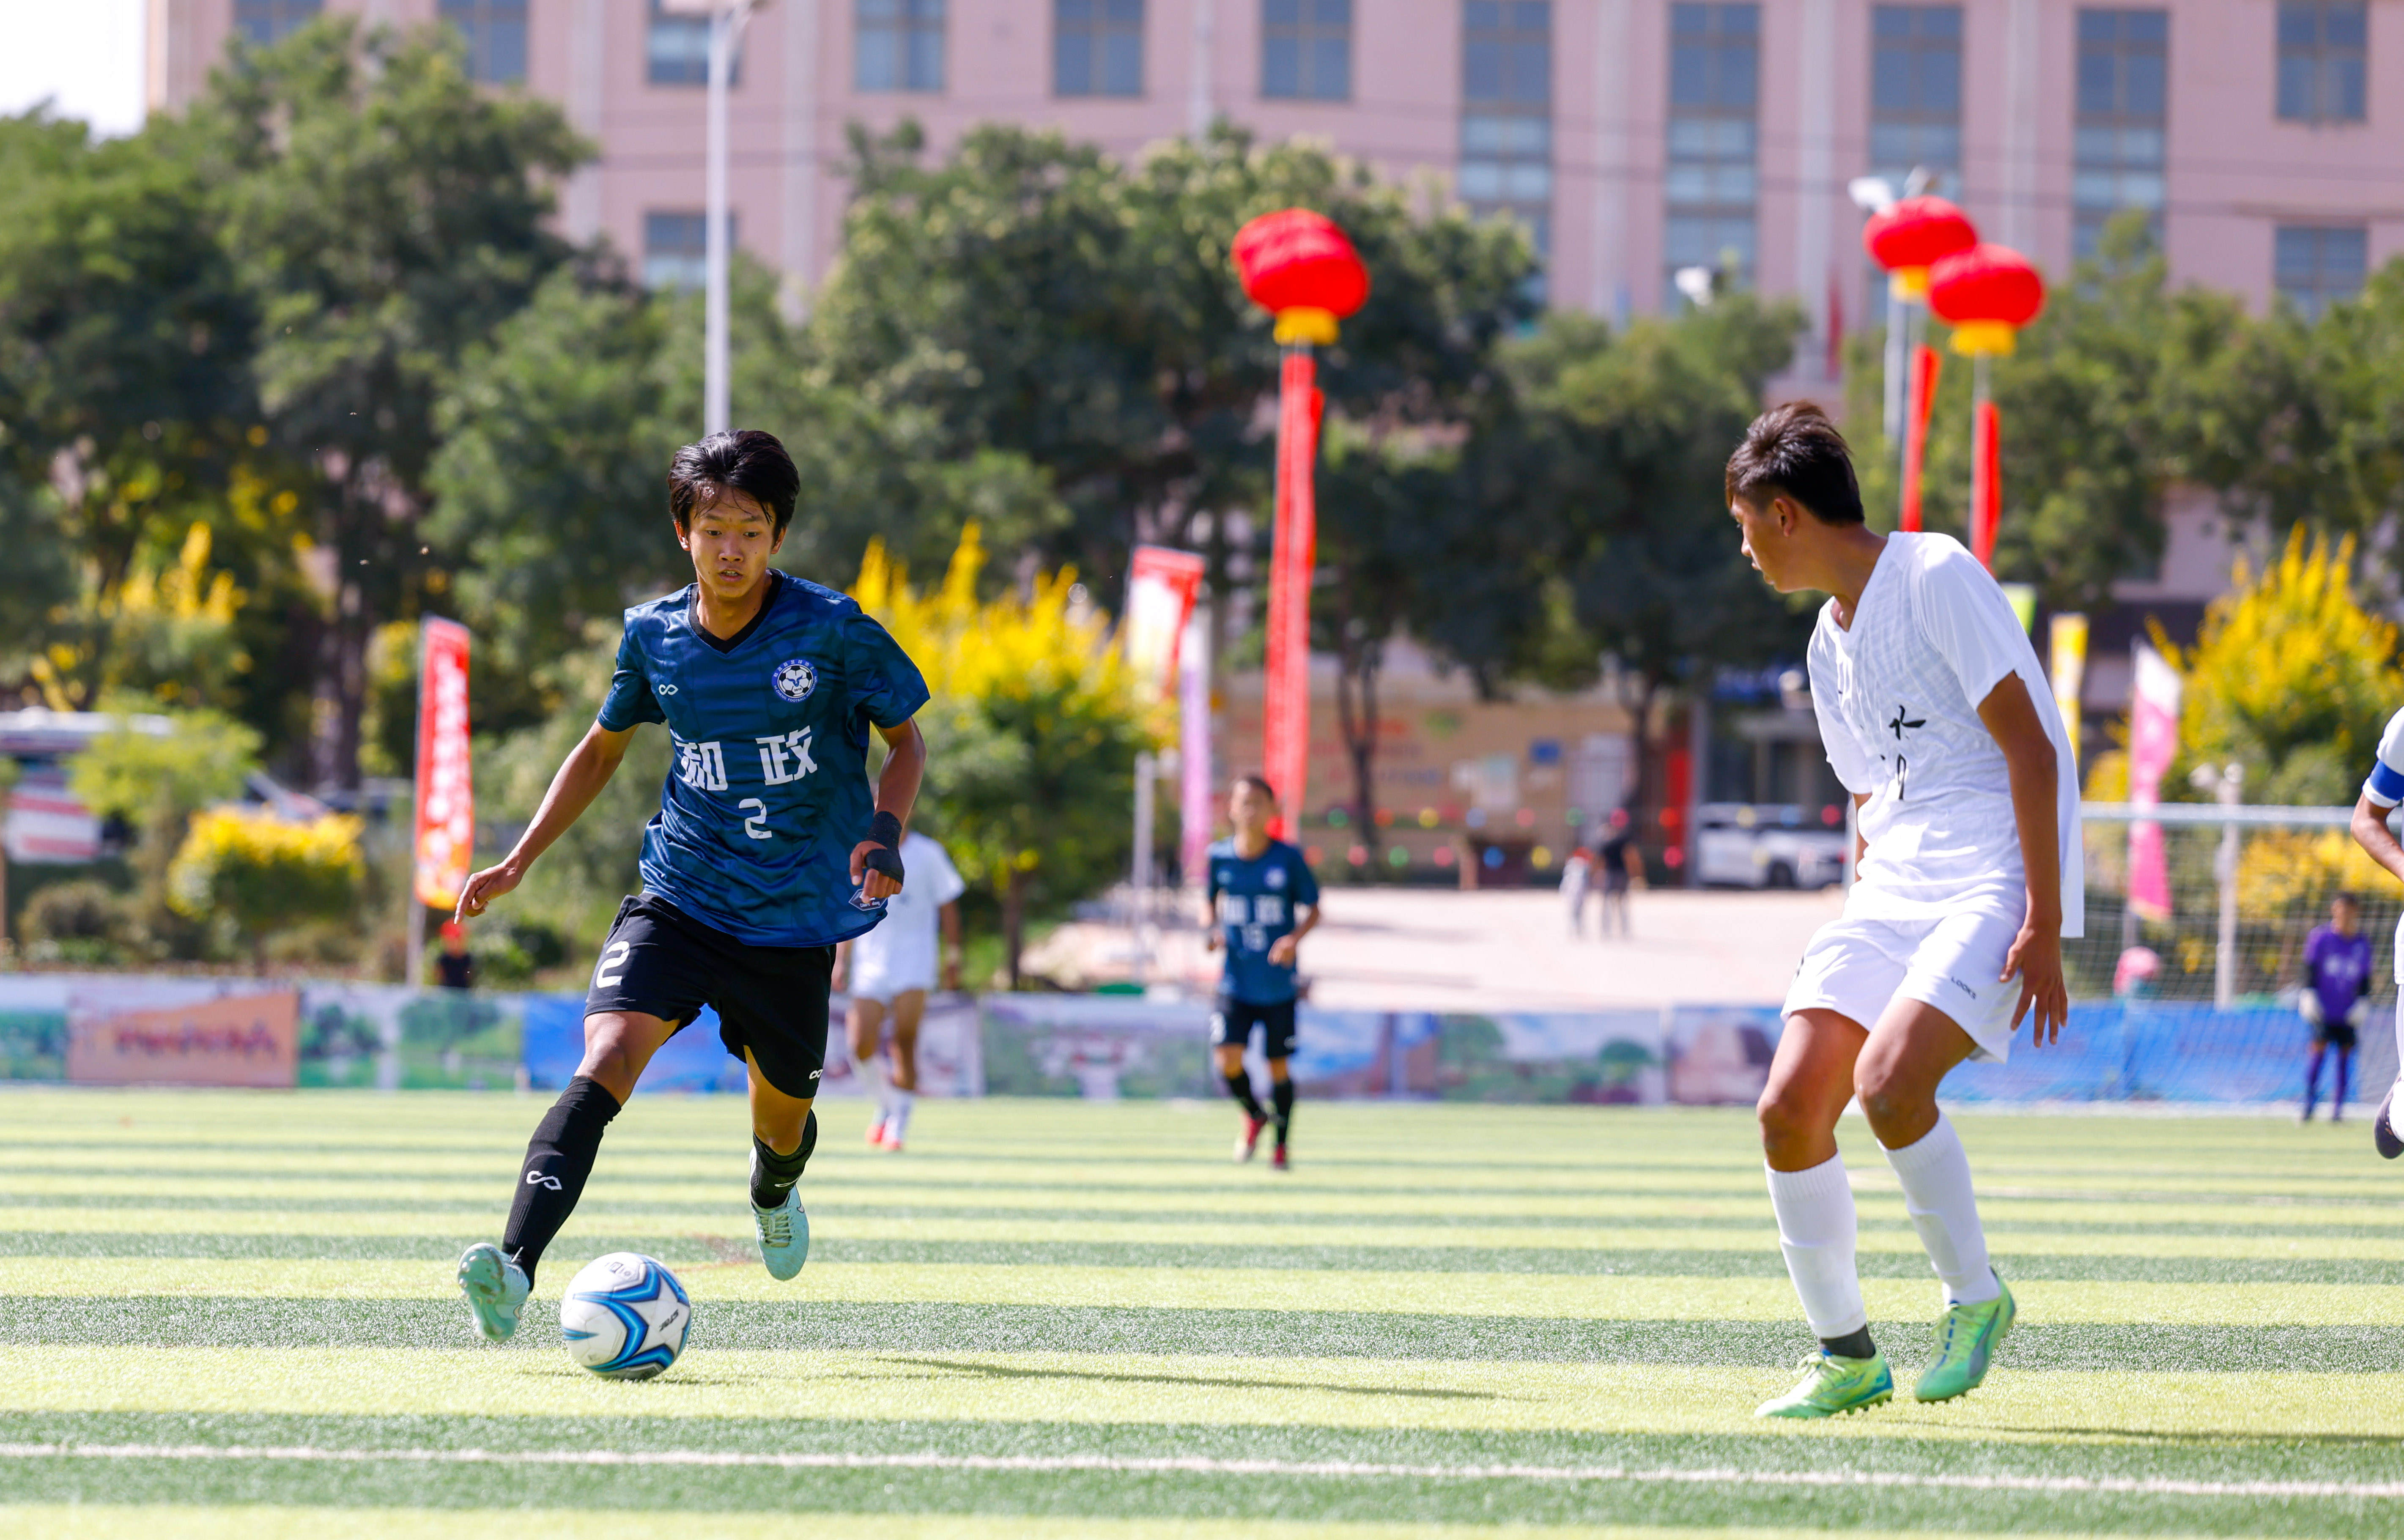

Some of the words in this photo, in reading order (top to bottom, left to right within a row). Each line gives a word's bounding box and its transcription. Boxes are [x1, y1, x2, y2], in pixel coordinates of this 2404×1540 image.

[674, 725, 817, 791] 和政
[738, 798, 773, 839] 2
[596, 941, 630, 988] 2
